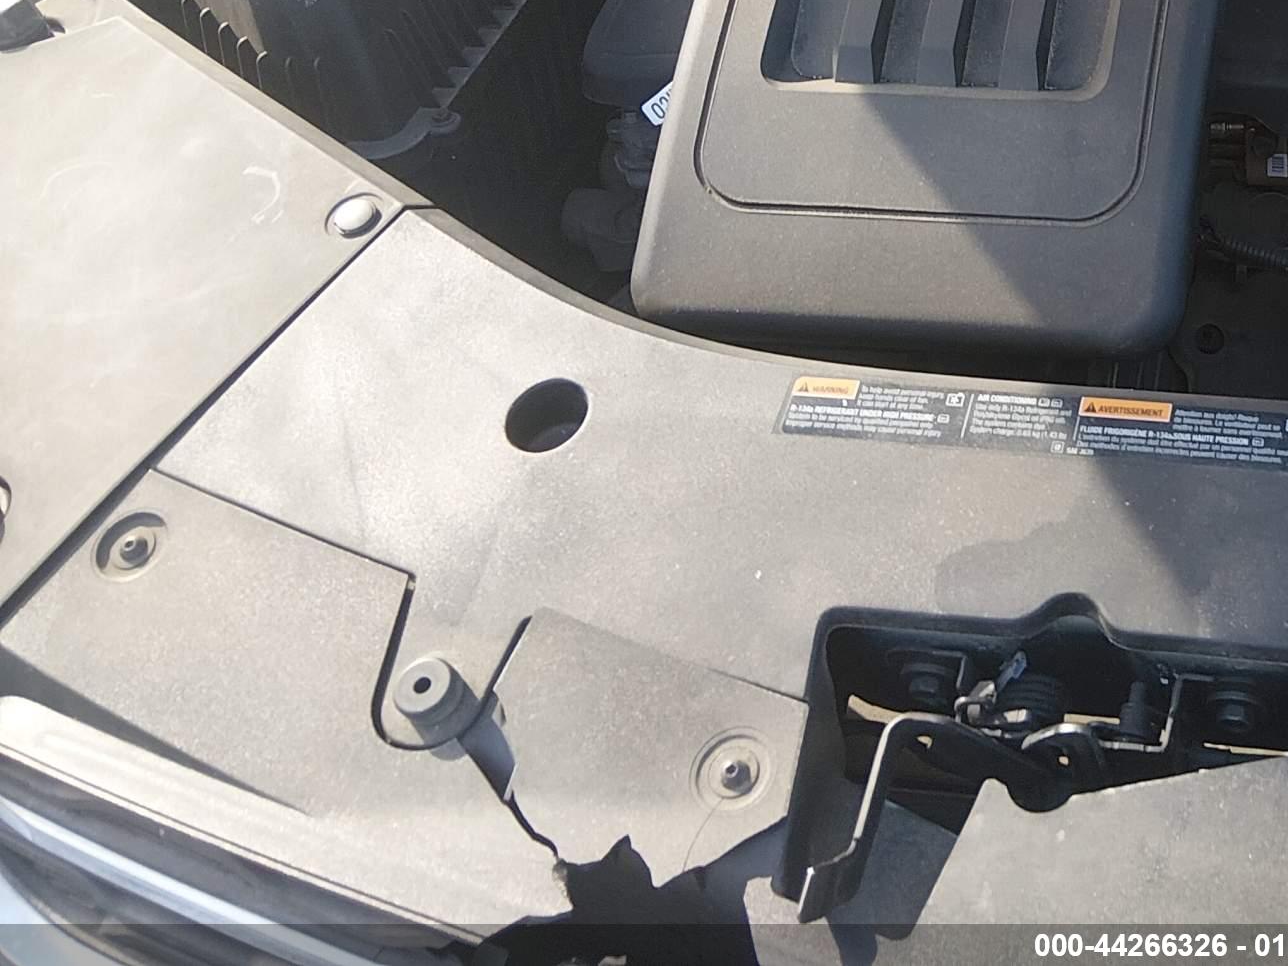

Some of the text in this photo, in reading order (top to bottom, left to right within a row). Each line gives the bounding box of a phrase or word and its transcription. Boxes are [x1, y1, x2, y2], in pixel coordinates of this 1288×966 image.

[812, 385, 849, 394] WARNING
[991, 395, 1037, 405] CONDITIONING
[859, 409, 882, 418] UNDER
[1097, 405, 1163, 418] AVERTISSEMENT
[1079, 424, 1103, 434] FLUIDE
[1191, 433, 1215, 443] HAUTE
[1215, 435, 1248, 446] PRESSION
